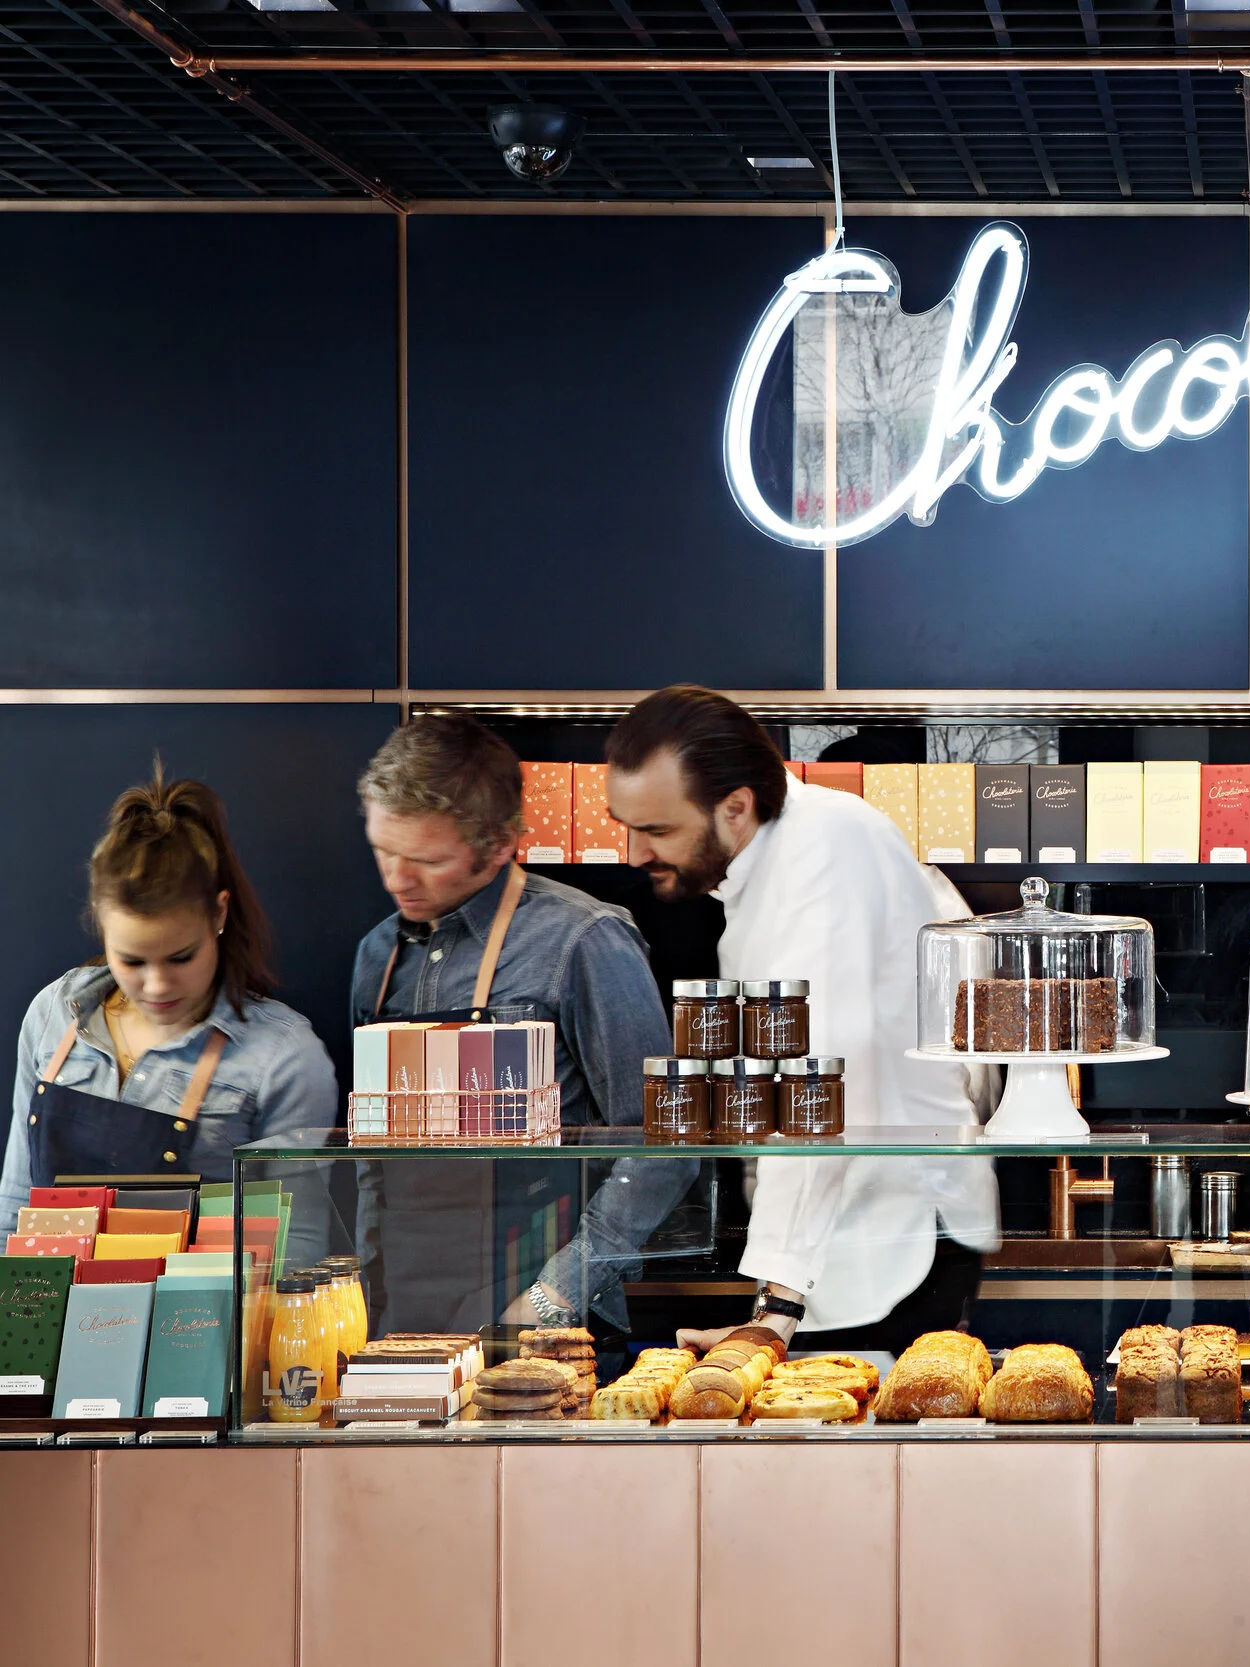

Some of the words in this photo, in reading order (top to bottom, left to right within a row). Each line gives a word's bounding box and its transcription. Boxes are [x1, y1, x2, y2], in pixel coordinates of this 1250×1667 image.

[982, 786, 1024, 799] Chocolaterie
[1036, 786, 1078, 799] Chocolaterie
[1208, 786, 1250, 799] Chocolaterie
[656, 1095, 693, 1108] Chocolaterie
[726, 1095, 763, 1108] Chocolaterie
[793, 1094, 830, 1108] Chocolaterie
[79, 1314, 138, 1332] Chocolaterie
[160, 1317, 220, 1336] Chocolaterie
[262, 1370, 324, 1396] LVF
[262, 1398, 273, 1407] La
